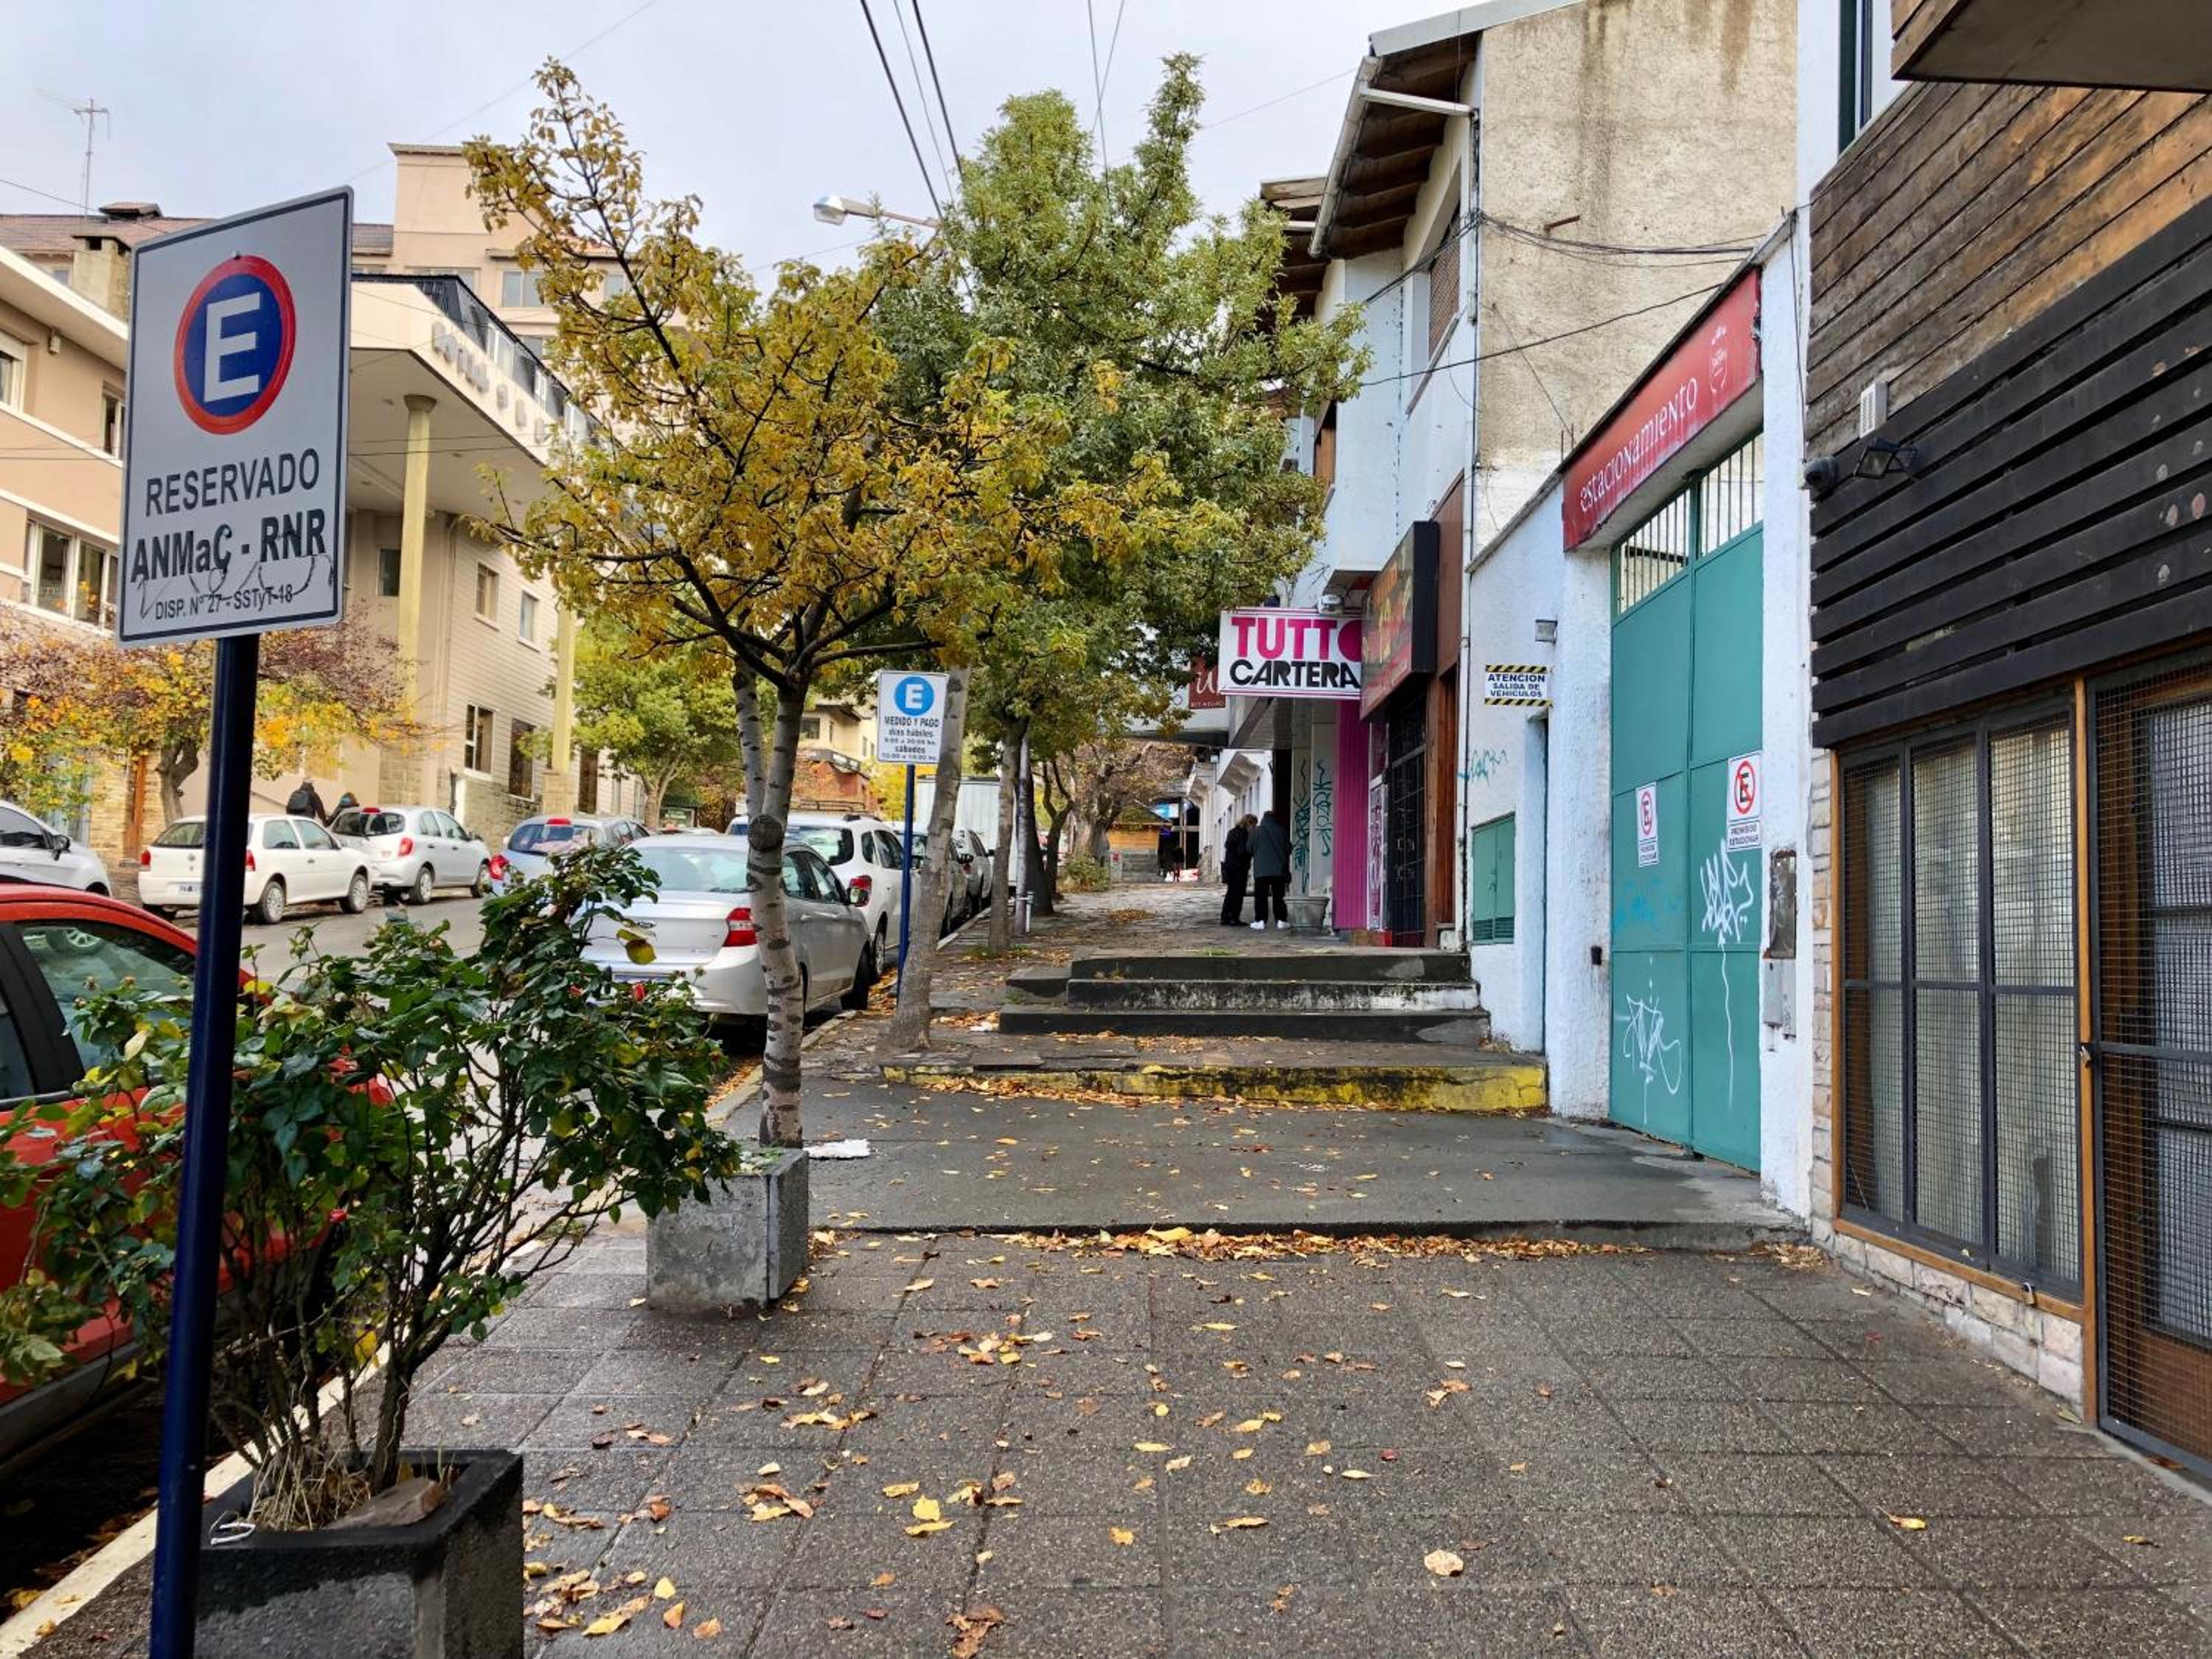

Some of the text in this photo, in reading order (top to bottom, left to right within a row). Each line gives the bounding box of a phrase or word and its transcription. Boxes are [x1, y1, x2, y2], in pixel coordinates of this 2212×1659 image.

[203, 292, 260, 403] E
[146, 448, 320, 517] RESERVADO
[131, 524, 232, 582] ANMaC
[260, 509, 326, 563] RNR
[156, 597, 186, 620] DISP.
[207, 592, 222, 613] 27
[1487, 673, 1545, 683] ATENCION
[905, 684, 924, 709] E
[920, 717, 939, 728] PAGO
